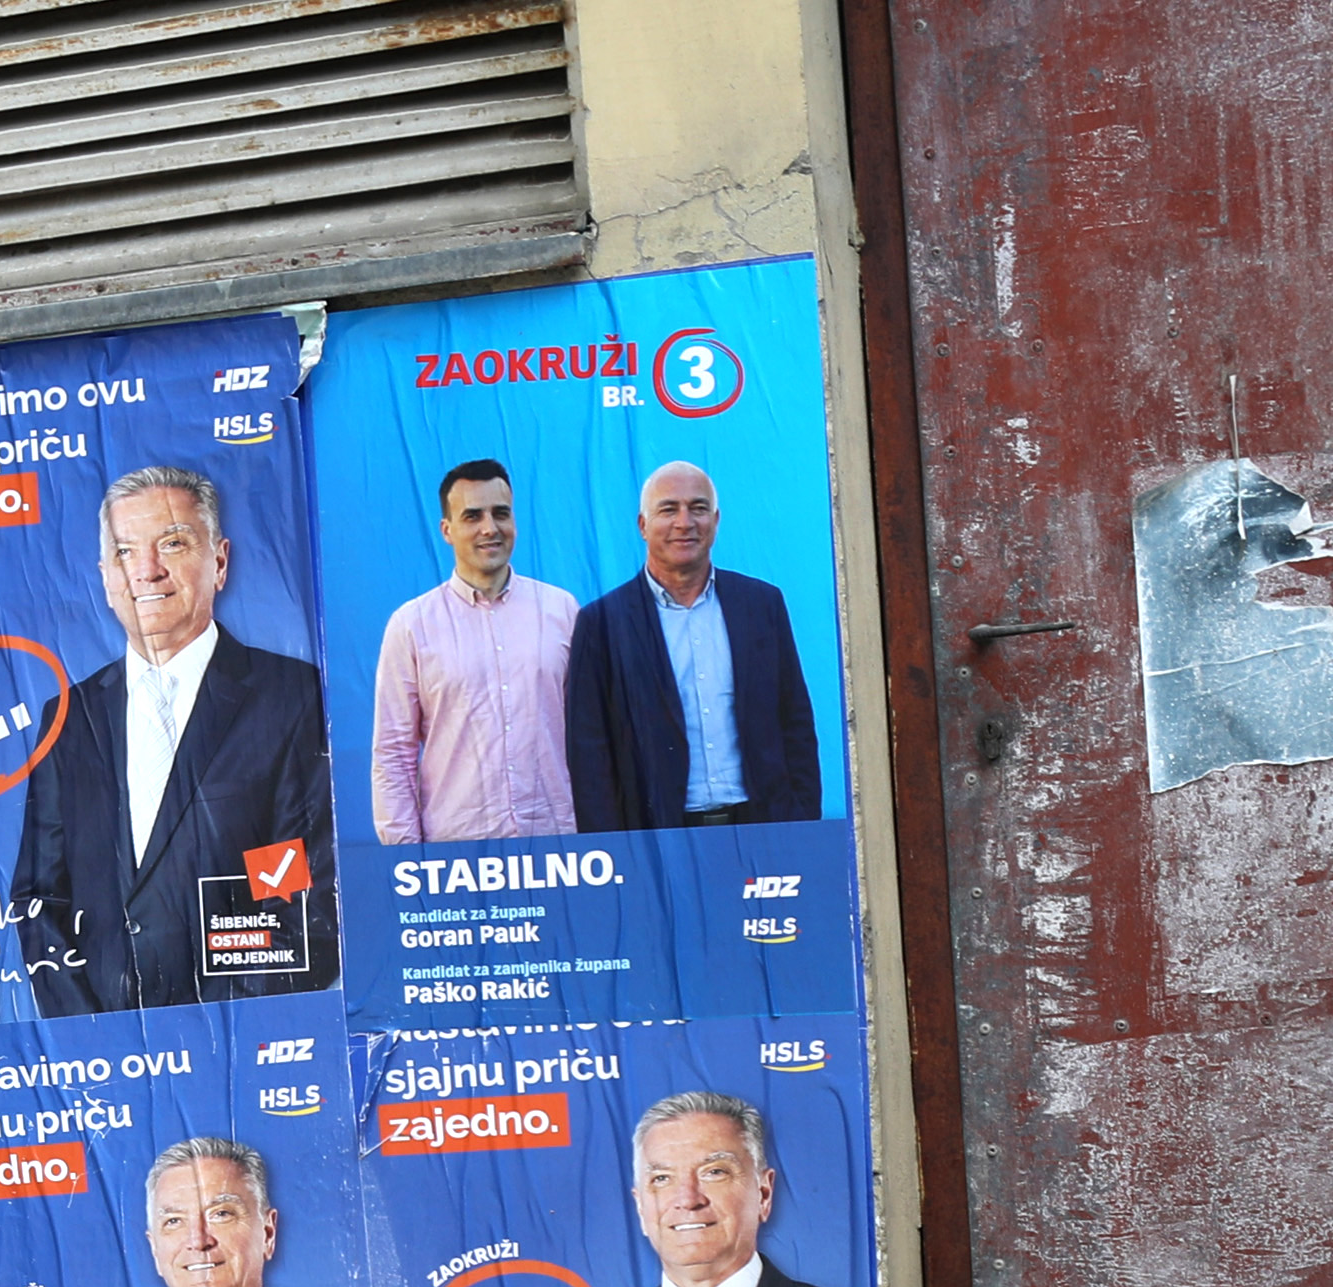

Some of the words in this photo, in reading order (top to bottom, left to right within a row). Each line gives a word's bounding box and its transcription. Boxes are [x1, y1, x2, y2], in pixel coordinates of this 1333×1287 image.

[415, 334, 638, 388] ZAOKRUŽI
[678, 345, 715, 399] 3
[212, 365, 270, 392] HDZ
[77, 377, 145, 407] ovu
[602, 385, 644, 407] BR.
[213, 412, 275, 438] HSLS
[394, 850, 624, 897] STABILNO.
[743, 875, 801, 899] HDZ
[210, 912, 281, 930] ŠIBENIČE,
[399, 908, 467, 924] Kandidat
[470, 908, 487, 921] za
[490, 904, 545, 922] župana
[743, 917, 797, 937] HSLS
[211, 932, 266, 947] OSTANI
[401, 924, 473, 948] Goran
[480, 922, 540, 944] Pauk
[212, 949, 294, 965] POBJEDNIK
[402, 964, 471, 980] Kandidat
[474, 964, 490, 977] za
[493, 959, 572, 978] zamjenika
[575, 956, 630, 974] župana
[404, 982, 476, 1005] Paško
[482, 976, 550, 1001] Rakić
[760, 1039, 826, 1066] HSLS
[385, 1057, 506, 1100] sjajnu
[515, 1050, 620, 1092] priču
[388, 1104, 559, 1143] zajedno.
[427, 1242, 519, 1287] ZAOKRUŽI
